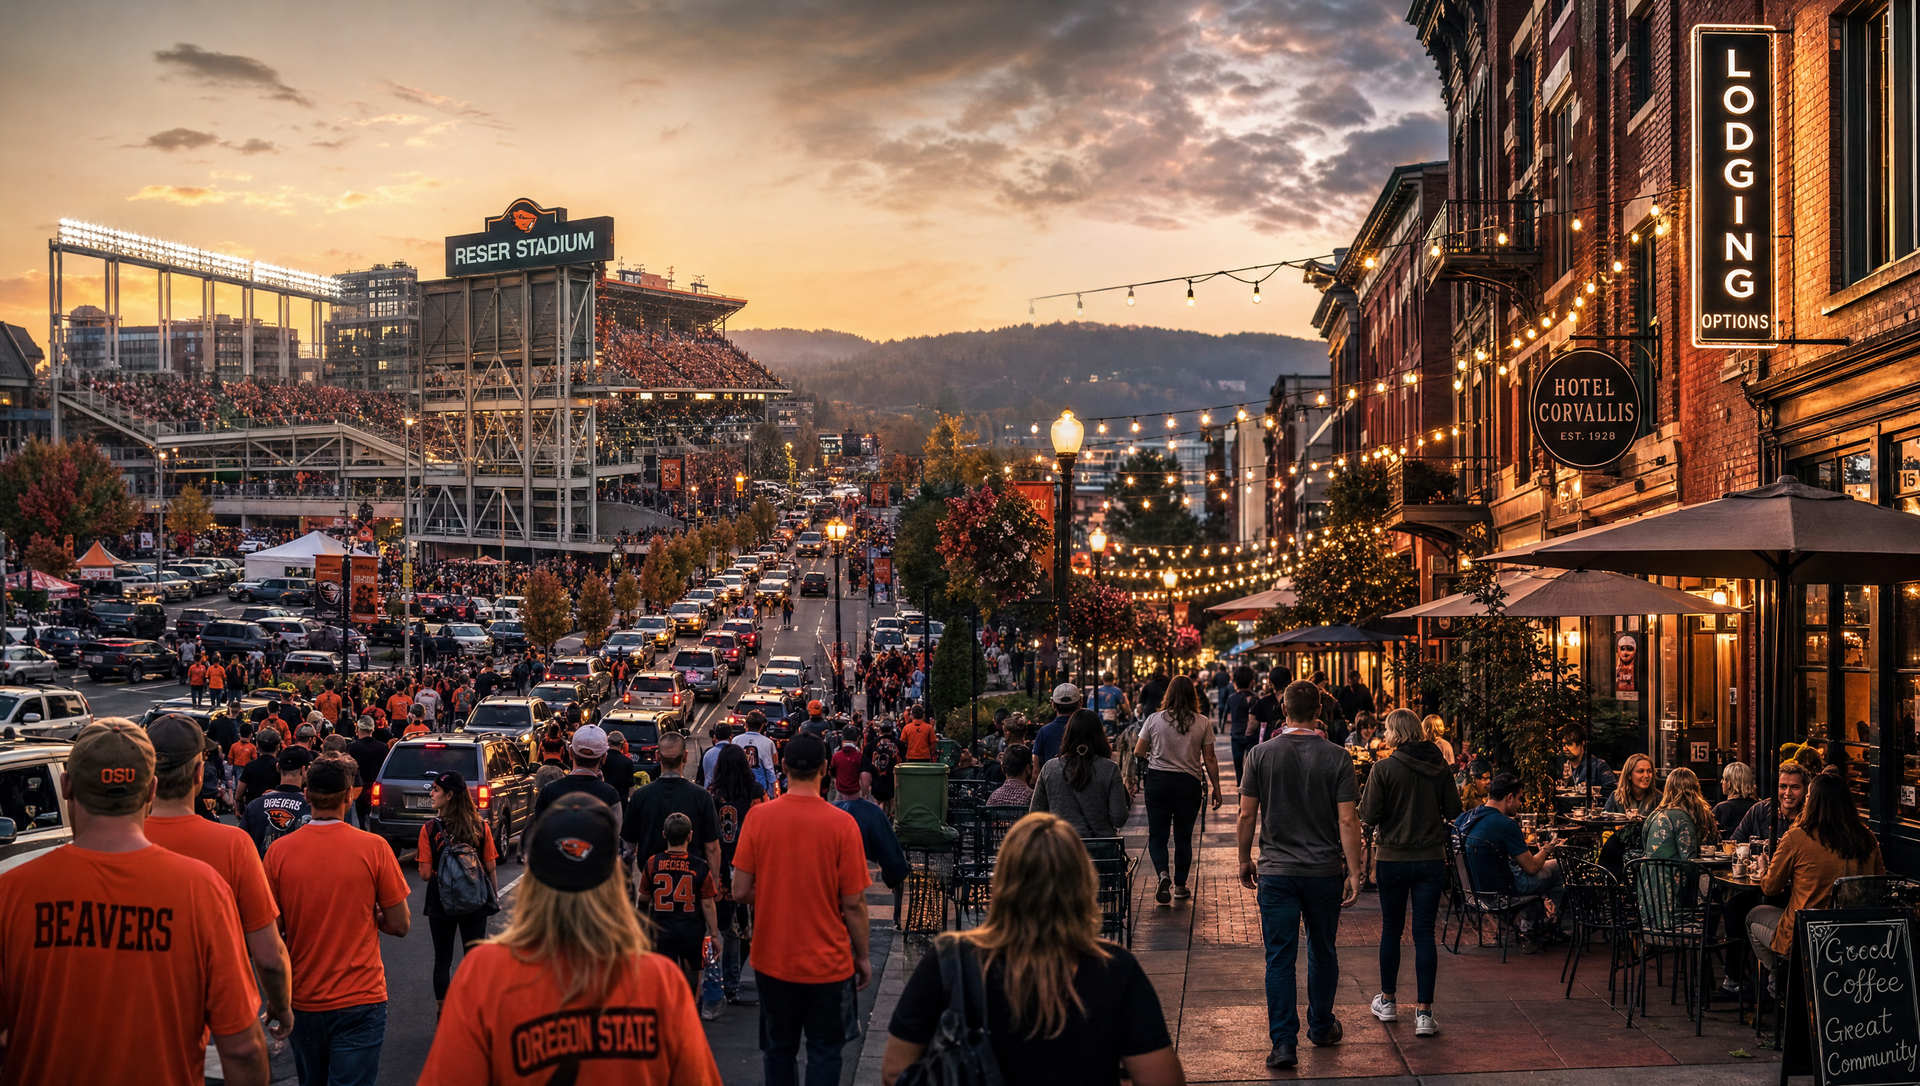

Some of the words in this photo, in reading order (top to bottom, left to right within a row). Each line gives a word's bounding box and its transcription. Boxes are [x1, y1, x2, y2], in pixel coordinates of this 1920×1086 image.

[1722, 48, 1755, 299] LODGING
[455, 242, 511, 266] RESER
[516, 230, 595, 258] STADIUM
[1701, 312, 1769, 330] OPTIONS
[1553, 377, 1615, 397] HOTEL
[1539, 402, 1635, 423] CORVALLIS
[1560, 431, 1585, 441] EST.
[1588, 430, 1616, 441] 1928
[1692, 745, 1707, 760] 15
[101, 767, 136, 784] OSU
[653, 873, 696, 912] 24
[34, 900, 173, 952] BEAVERS
[1823, 967, 1904, 1004] Coffee
[516, 1015, 594, 1070] OREGON
[597, 1015, 657, 1053] STATE
[1827, 1038, 1918, 1076] Community
